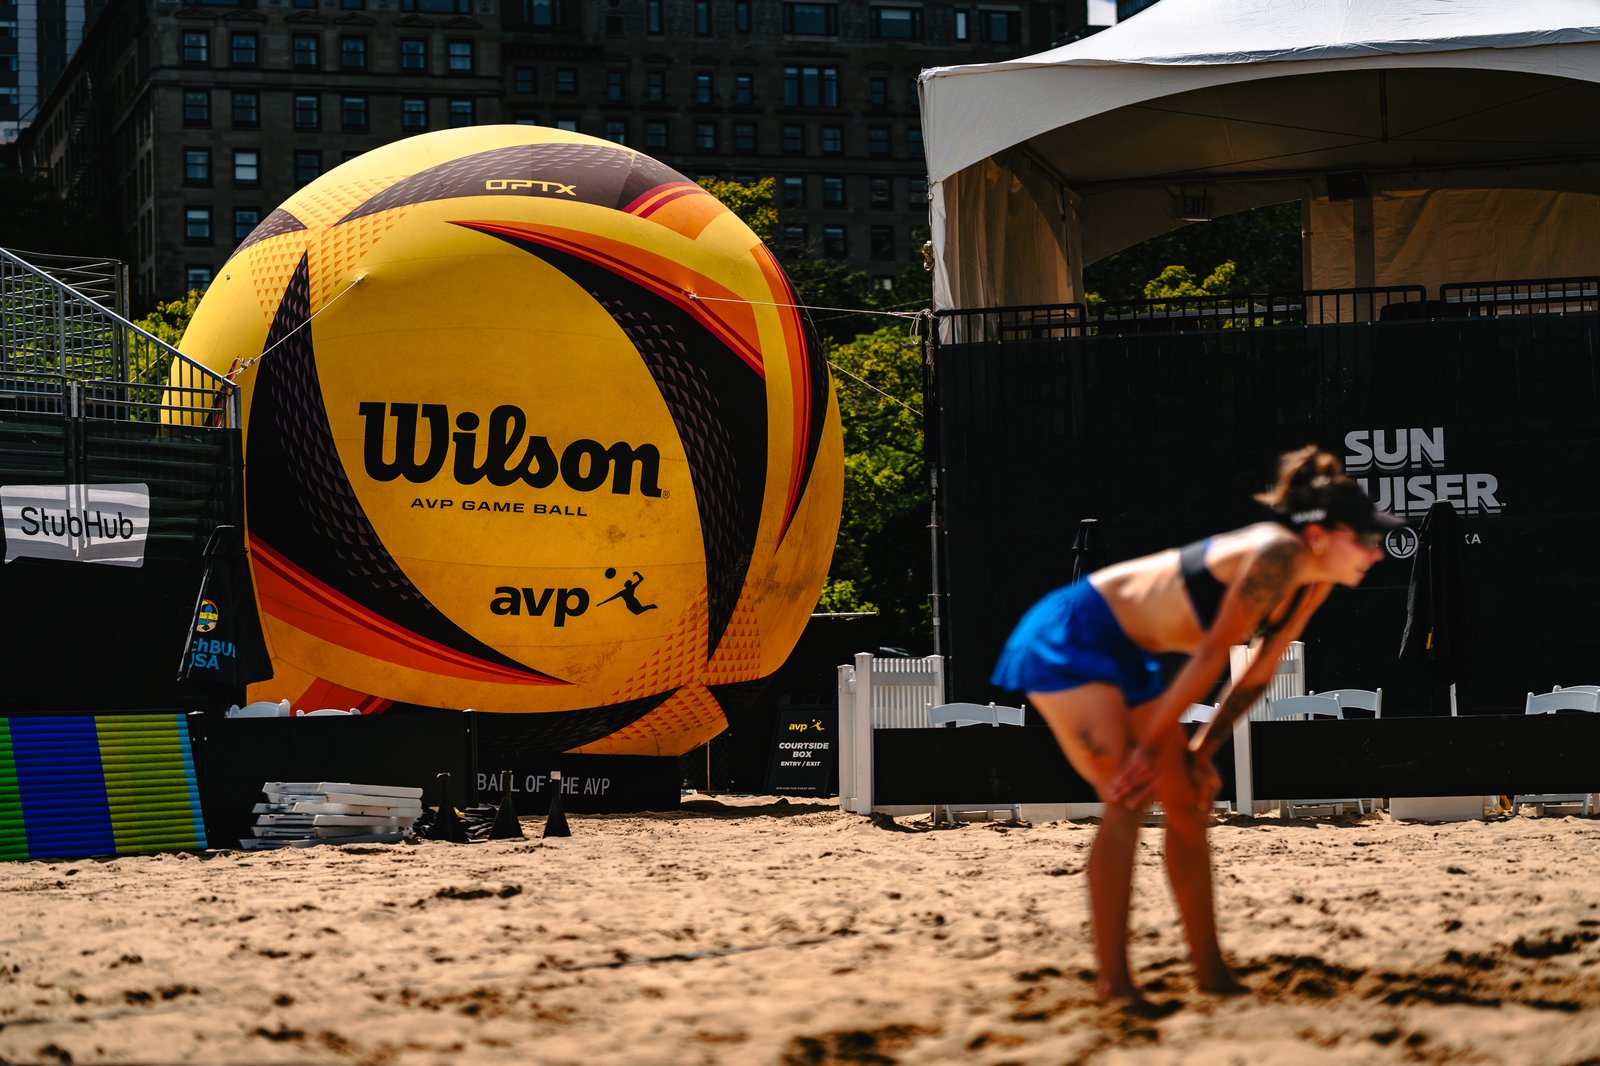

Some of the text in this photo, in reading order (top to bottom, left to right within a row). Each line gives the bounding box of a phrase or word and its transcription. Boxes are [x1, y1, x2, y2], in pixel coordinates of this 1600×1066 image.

[485, 179, 577, 196] OPTX
[358, 401, 662, 498] Wilson
[1344, 427, 1445, 470] SUN
[410, 498, 588, 517] AVP GAME BALL
[1356, 473, 1501, 516] UISER
[21, 506, 134, 540] StubHub
[489, 585, 590, 627] avp
[788, 723, 808, 732] avp
[779, 742, 829, 750] COURTSIDE
[525, 775, 546, 793] OF
[560, 776, 580, 794] HE
[583, 778, 610, 795] AVP
